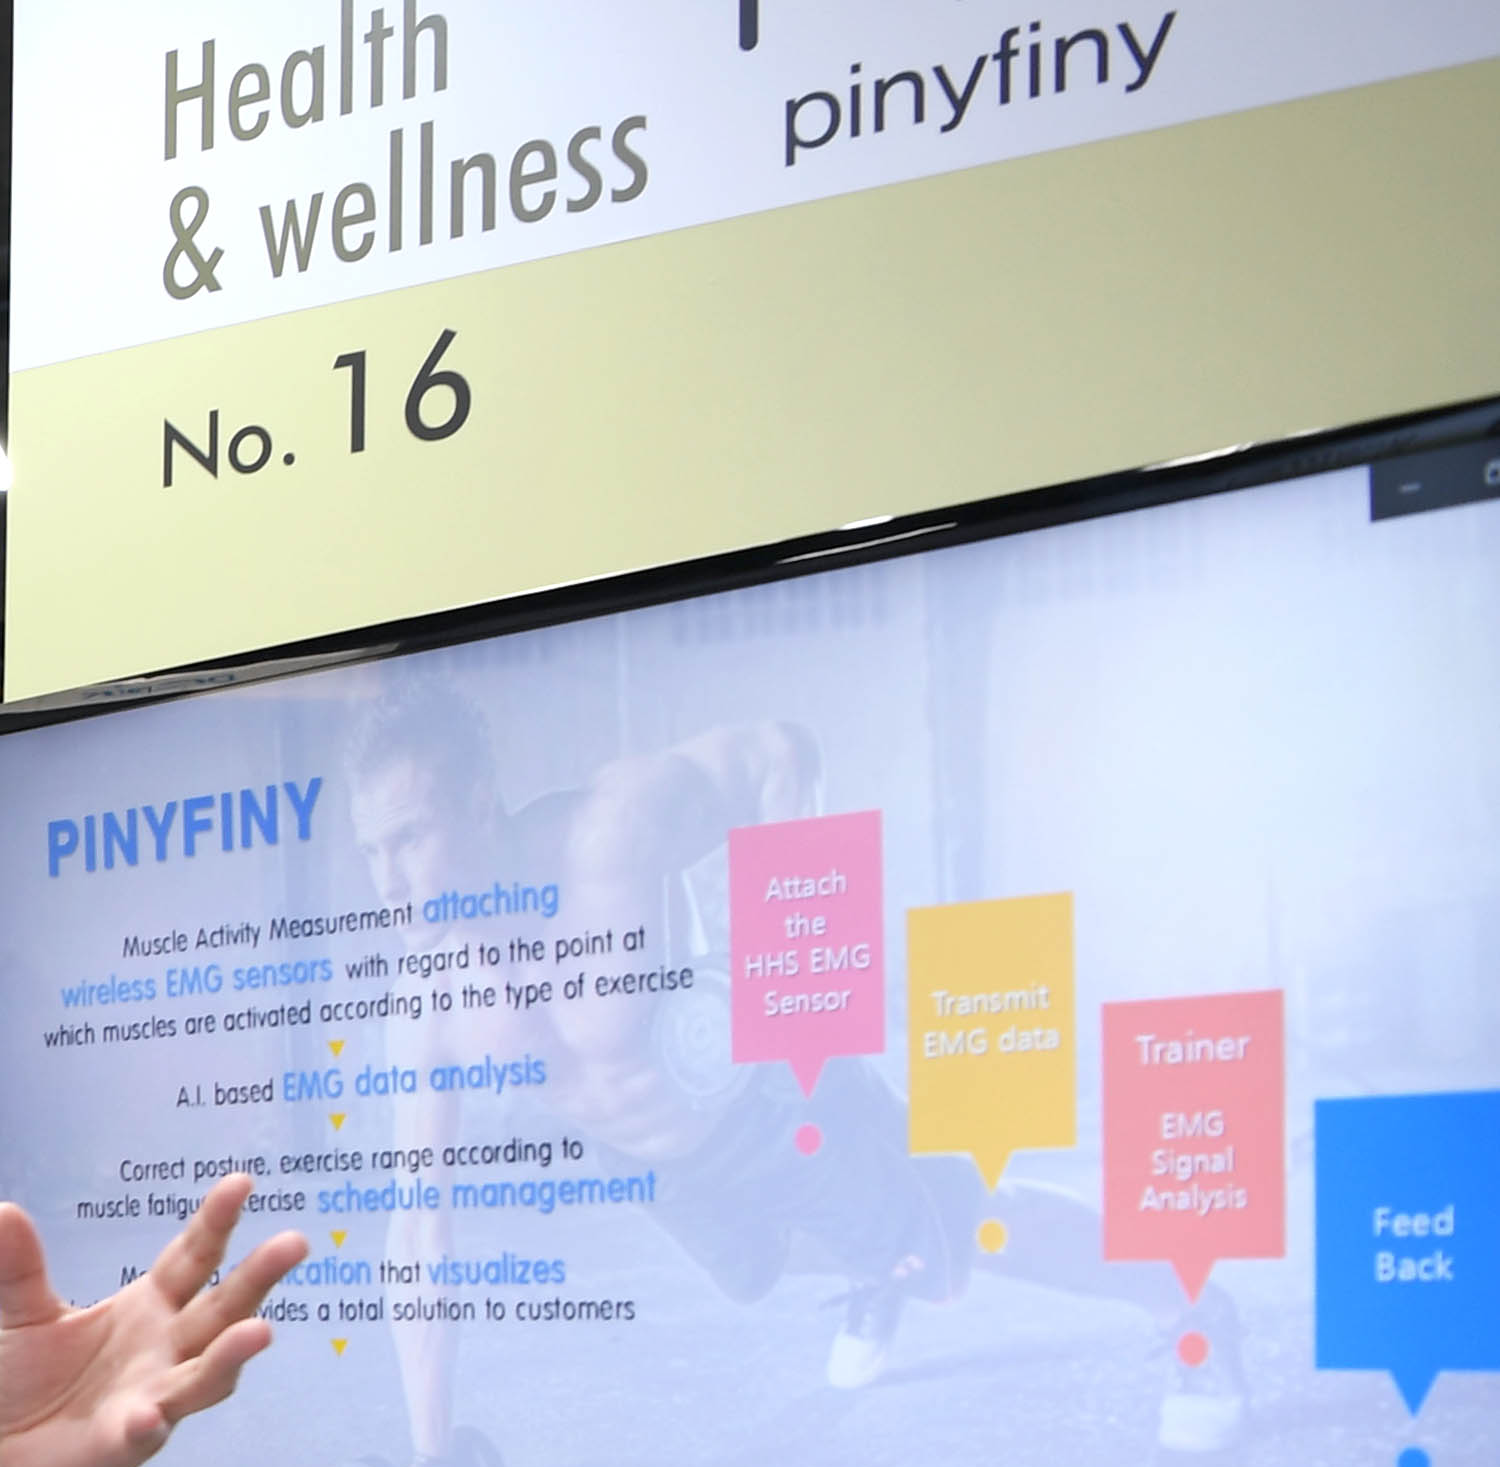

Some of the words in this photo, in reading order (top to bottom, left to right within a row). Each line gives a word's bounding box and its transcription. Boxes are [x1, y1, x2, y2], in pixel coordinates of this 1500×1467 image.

[165, 0, 448, 161] Health
[784, 8, 1177, 168] pinyfiny
[162, 185, 225, 301] &
[258, 114, 649, 279] wellness
[163, 408, 295, 489] No.
[333, 328, 472, 454] 16
[48, 777, 322, 878] PINYFINY
[765, 868, 847, 902] Attach
[122, 930, 188, 959] Muscle
[195, 922, 261, 950] Activity
[269, 902, 412, 942] Measurement
[423, 881, 559, 924] attaching
[785, 911, 826, 939] the
[61, 974, 157, 1008] wireless
[166, 965, 223, 998] EMG
[233, 957, 333, 991] sensors
[345, 955, 388, 980] with
[397, 943, 470, 979] regard
[479, 943, 501, 966] to
[509, 937, 545, 962] the
[555, 929, 613, 964] point
[623, 925, 646, 952] at
[745, 952, 800, 979] HHS
[810, 943, 872, 975] EMG
[44, 1021, 95, 1049] which
[103, 1015, 177, 1043] muscles
[185, 1013, 216, 1036] are
[224, 999, 311, 1033] activated
[320, 992, 423, 1022] according
[432, 988, 453, 1012] to
[462, 983, 496, 1009] the
[505, 980, 553, 1011] type
[564, 973, 585, 1000] of
[595, 965, 694, 997] exercise
[764, 988, 852, 1017] Sensor
[930, 984, 1050, 1018] Transmit
[923, 1028, 987, 1059] EMG
[999, 1025, 1061, 1052] data
[1135, 1030, 1250, 1066] Trainer
[214, 1078, 274, 1107] based
[282, 1068, 343, 1102] EMG
[355, 1064, 417, 1097] data
[430, 1054, 548, 1095] analysis
[1161, 1111, 1225, 1139] EMG
[120, 1157, 186, 1182] Correct
[280, 1148, 362, 1175] exercise
[371, 1147, 434, 1173] range
[443, 1137, 552, 1168] according
[562, 1136, 584, 1160] to
[1151, 1147, 1236, 1182] Signal
[77, 1193, 141, 1219] muscle
[147, 1194, 206, 1221] fatigu
[241, 1189, 306, 1213] ercise
[317, 1177, 440, 1214] schedule
[451, 1170, 656, 1215] management
[1139, 1184, 1248, 1216] Analysis
[1372, 1204, 1456, 1237] Feed
[380, 1260, 421, 1284] that
[428, 1252, 567, 1285] visualizes
[1374, 1251, 1455, 1284] Back
[317, 1302, 330, 1322] a
[338, 1296, 384, 1322] total
[392, 1296, 476, 1322] solution
[486, 1297, 505, 1322] to
[515, 1297, 636, 1322] customers
